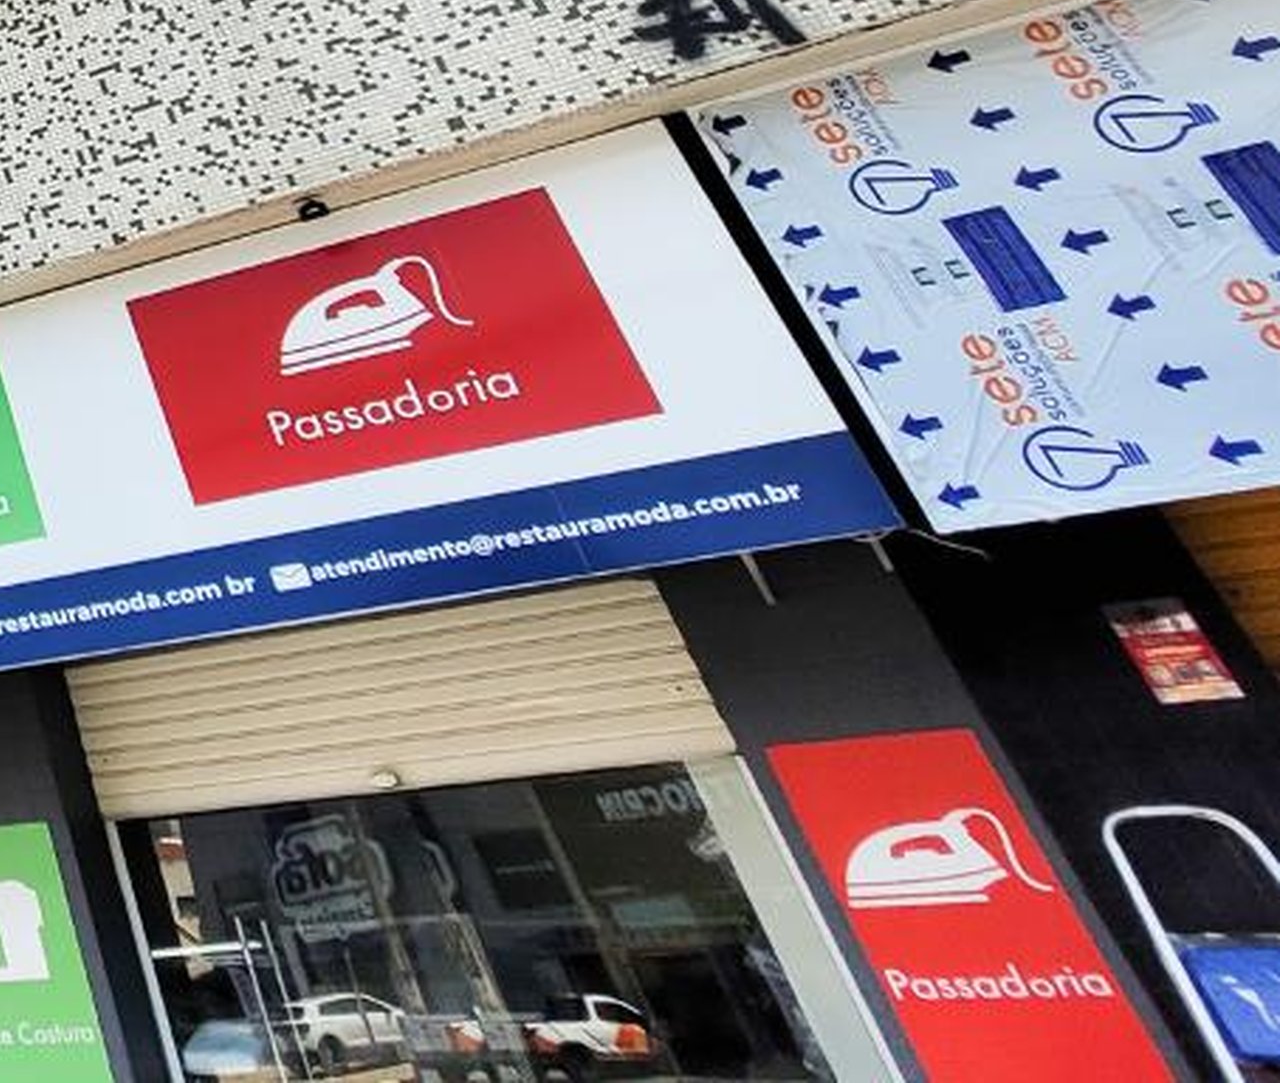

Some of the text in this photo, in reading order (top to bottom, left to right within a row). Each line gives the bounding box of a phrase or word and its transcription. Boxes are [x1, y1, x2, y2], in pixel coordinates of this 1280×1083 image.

[1024, 20, 1109, 100] sete
[790, 86, 864, 166] sete
[266, 368, 520, 447] Passadoria
[960, 333, 1039, 427] sete
[997, 325, 1068, 422] soluções
[311, 481, 802, 585] atendimento@restauramoda.com.br
[884, 962, 1115, 1003] Passadoria
[17, 1020, 96, 1045] Costura
